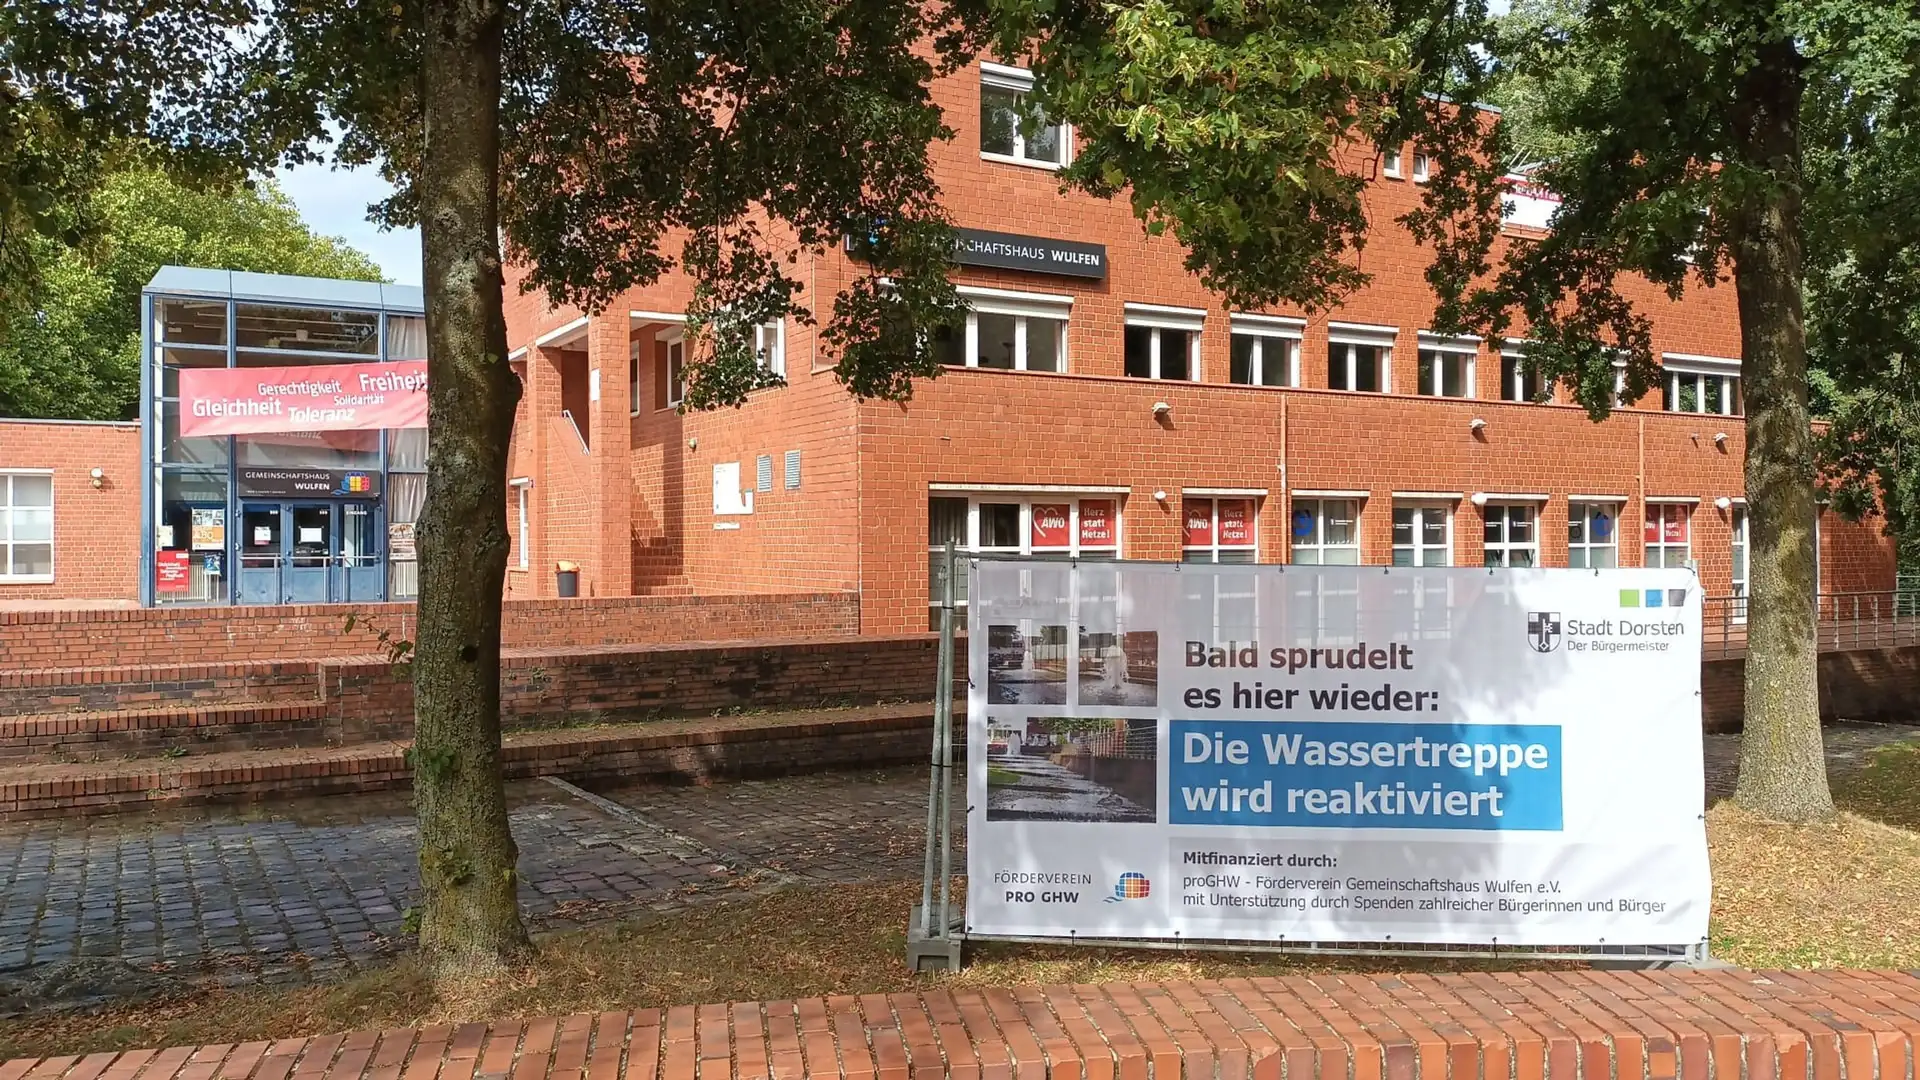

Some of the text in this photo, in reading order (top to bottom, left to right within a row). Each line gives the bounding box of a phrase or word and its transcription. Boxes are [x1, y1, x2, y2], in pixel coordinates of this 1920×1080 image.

[1051, 249, 1100, 266] WULFEN
[257, 380, 342, 398] Gerechtigkeit
[192, 396, 282, 417] Gleichheit
[288, 406, 356, 423] Toleranz
[245, 471, 330, 480] GEMEINSCHAFTSHAUS
[1083, 507, 1104, 517] Herz
[1041, 517, 1065, 528] AWO
[1083, 519, 1105, 528] statt
[1186, 518, 1208, 529] AWO
[1223, 520, 1244, 528] statt
[1082, 529, 1110, 539] Hetze!
[1223, 530, 1248, 539] Hetze!
[1567, 619, 1684, 636] Stadt Dorsten
[1567, 640, 1669, 654] Der Bürgermeister
[1185, 641, 1413, 675] Bald sprudelt
[1183, 681, 1439, 712] es hier wieder:
[1183, 731, 1549, 776] Die Wassertreppe
[1181, 779, 1504, 817] wird reaktiviert
[1183, 852, 1337, 867] Mitfinanziert durch:
[994, 869, 1092, 885] FÖRDERVEREIN
[1183, 874, 1240, 890] proGHW
[1256, 875, 1341, 890] Förderverein
[1346, 877, 1480, 892] Gemeinschaftshaus
[1485, 880, 1532, 893] Wulfen
[1537, 880, 1561, 893] e.V.
[1005, 891, 1080, 903] PRO GHW
[1183, 893, 1666, 915] mit Unterstützung durch Spenden zahlreicher Bürgerinnen und Bürger
